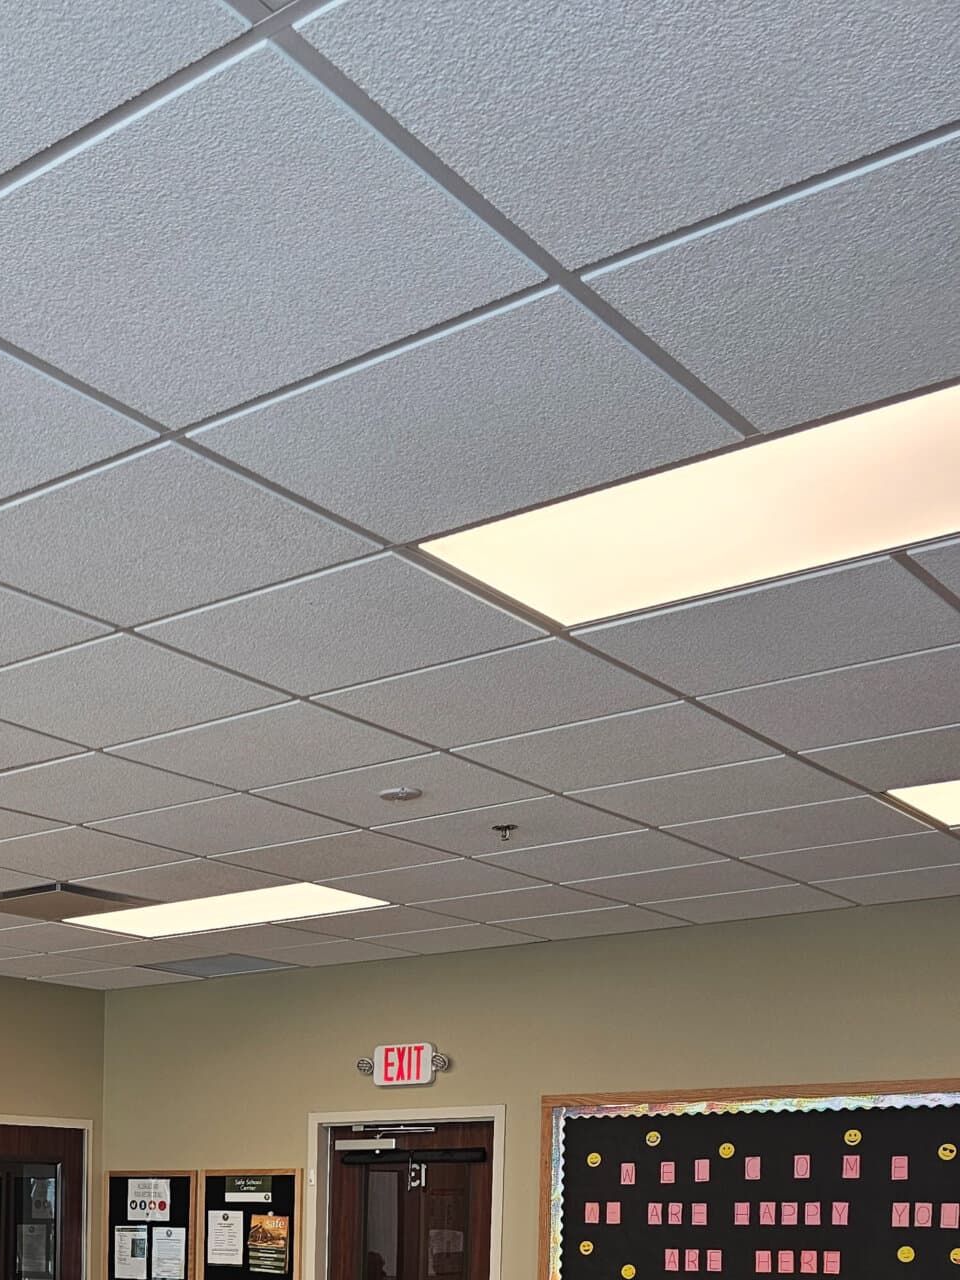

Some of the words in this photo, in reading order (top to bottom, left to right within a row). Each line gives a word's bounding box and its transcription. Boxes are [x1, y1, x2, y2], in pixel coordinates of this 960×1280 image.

[383, 1045, 424, 1082] EXIT
[649, 1204, 707, 1224] ARE
[736, 1203, 848, 1224] HAPPY
[893, 1204, 958, 1227] YOU
[667, 1251, 721, 1271] ARE
[757, 1252, 839, 1273] HERE
